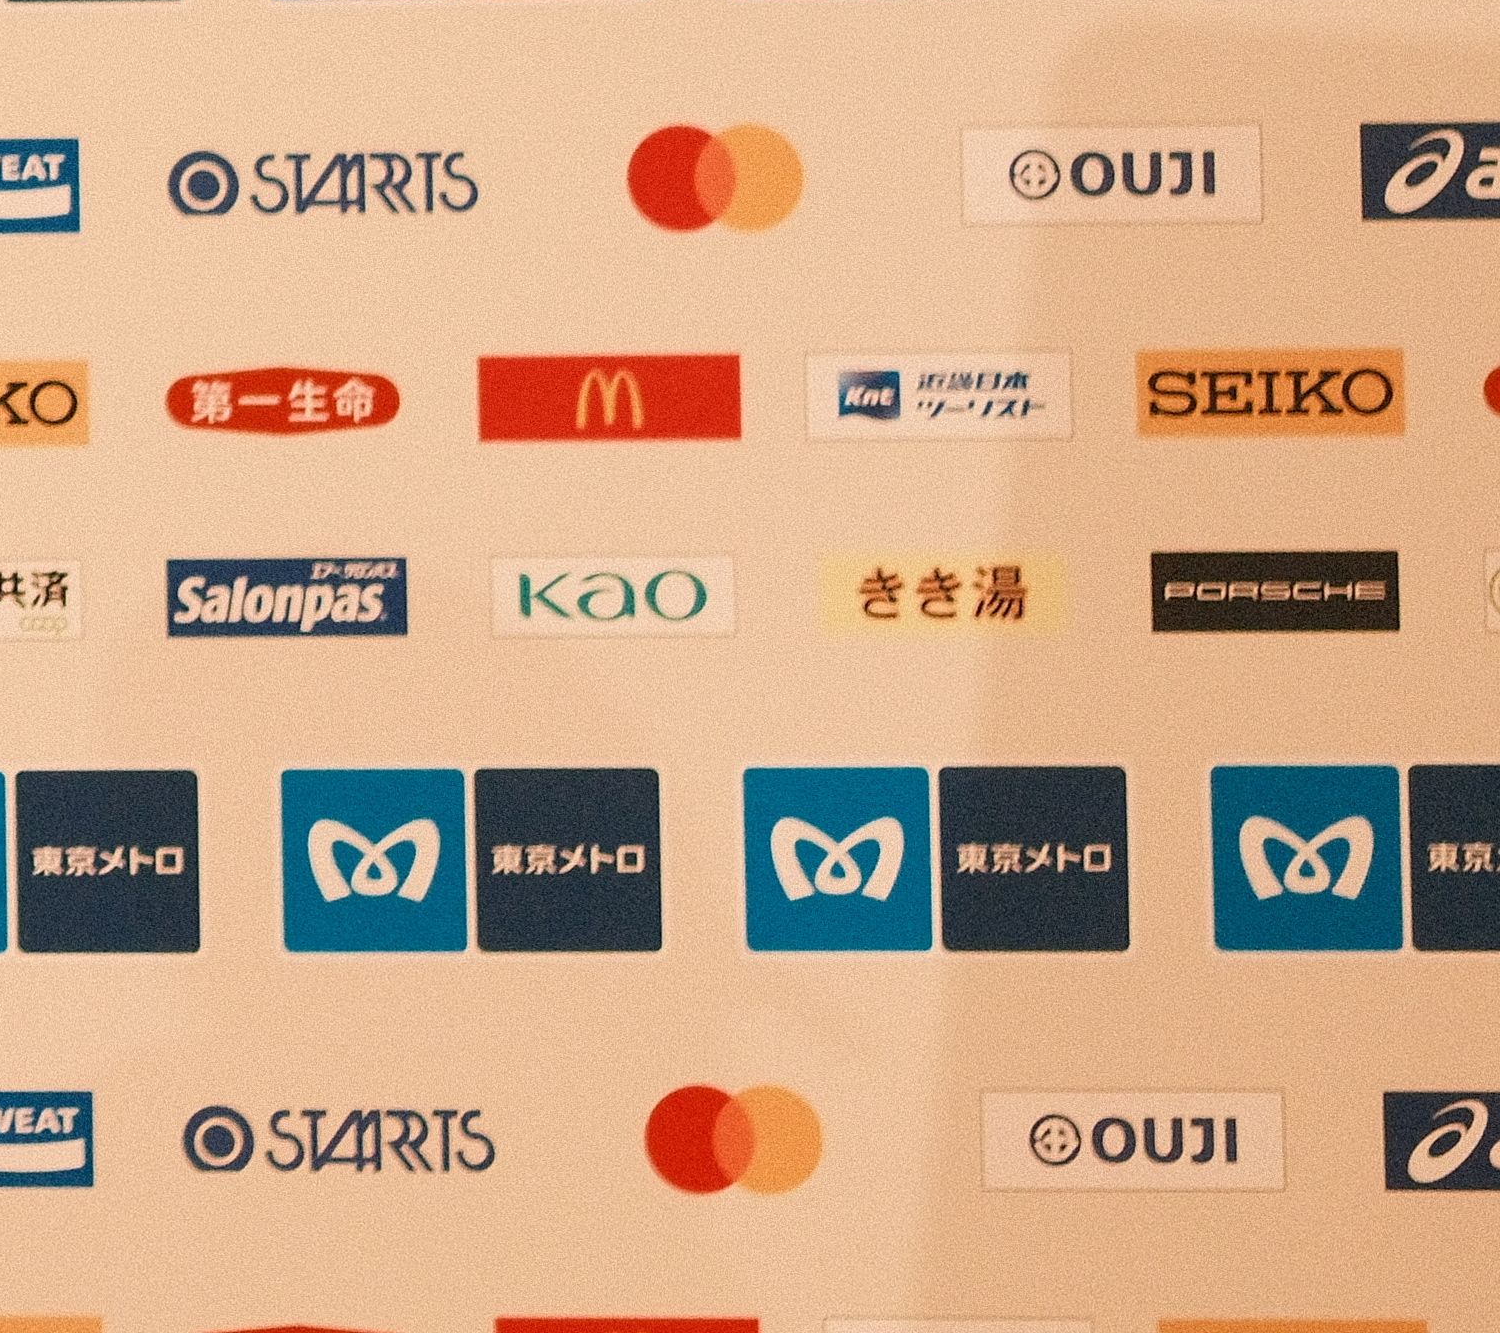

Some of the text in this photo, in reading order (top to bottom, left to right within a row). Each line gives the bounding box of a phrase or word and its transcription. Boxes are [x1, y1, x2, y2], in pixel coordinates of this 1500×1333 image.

[1071, 151, 1215, 197] OUJI
[192, 378, 374, 423] 第一生命
[1148, 368, 1393, 417] SEIKO
[174, 576, 383, 632] Salonpas
[861, 566, 1027, 620] きき湯
[34, 846, 183, 876] 東京メトロ
[958, 844, 1111, 873] 東京メトロ
[1092, 1117, 1237, 1164] OUJI
